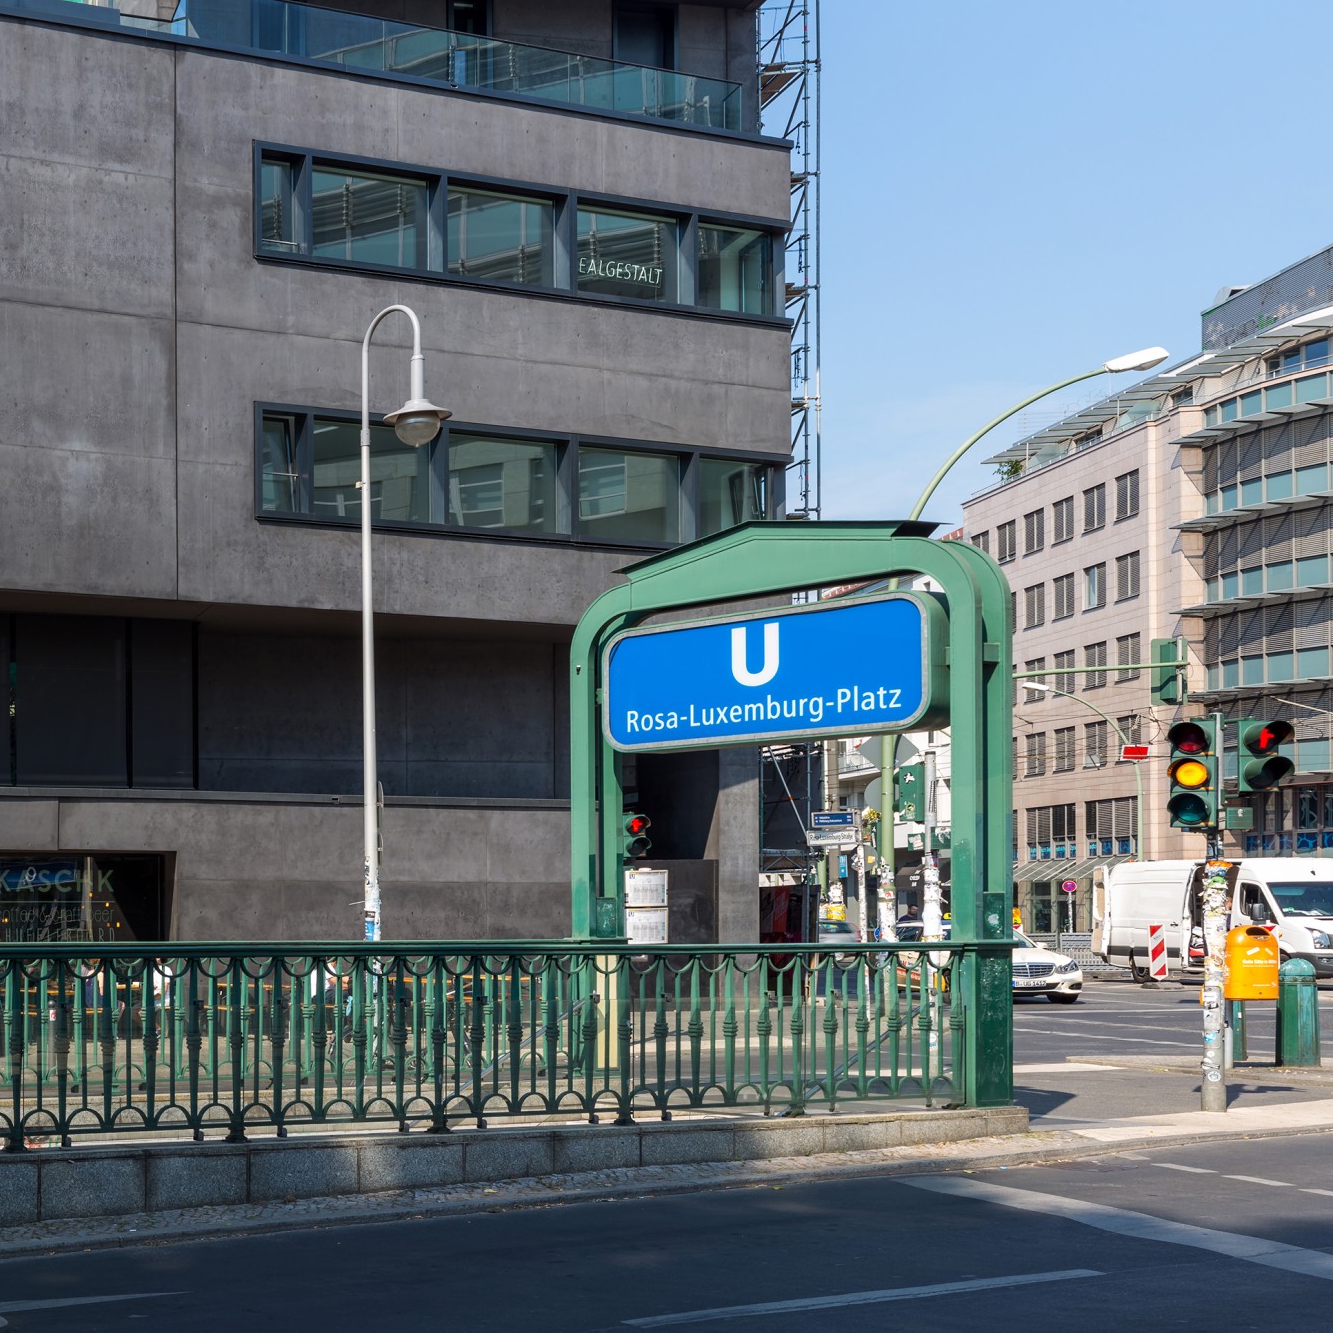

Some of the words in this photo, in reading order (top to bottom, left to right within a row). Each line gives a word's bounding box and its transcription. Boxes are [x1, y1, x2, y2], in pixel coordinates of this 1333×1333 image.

[731, 622, 780, 687] U
[626, 685, 902, 733] Rosa-Luxemburg-Platz
[0, 869, 114, 892] KASCHK
[1, 907, 37, 924] offee
